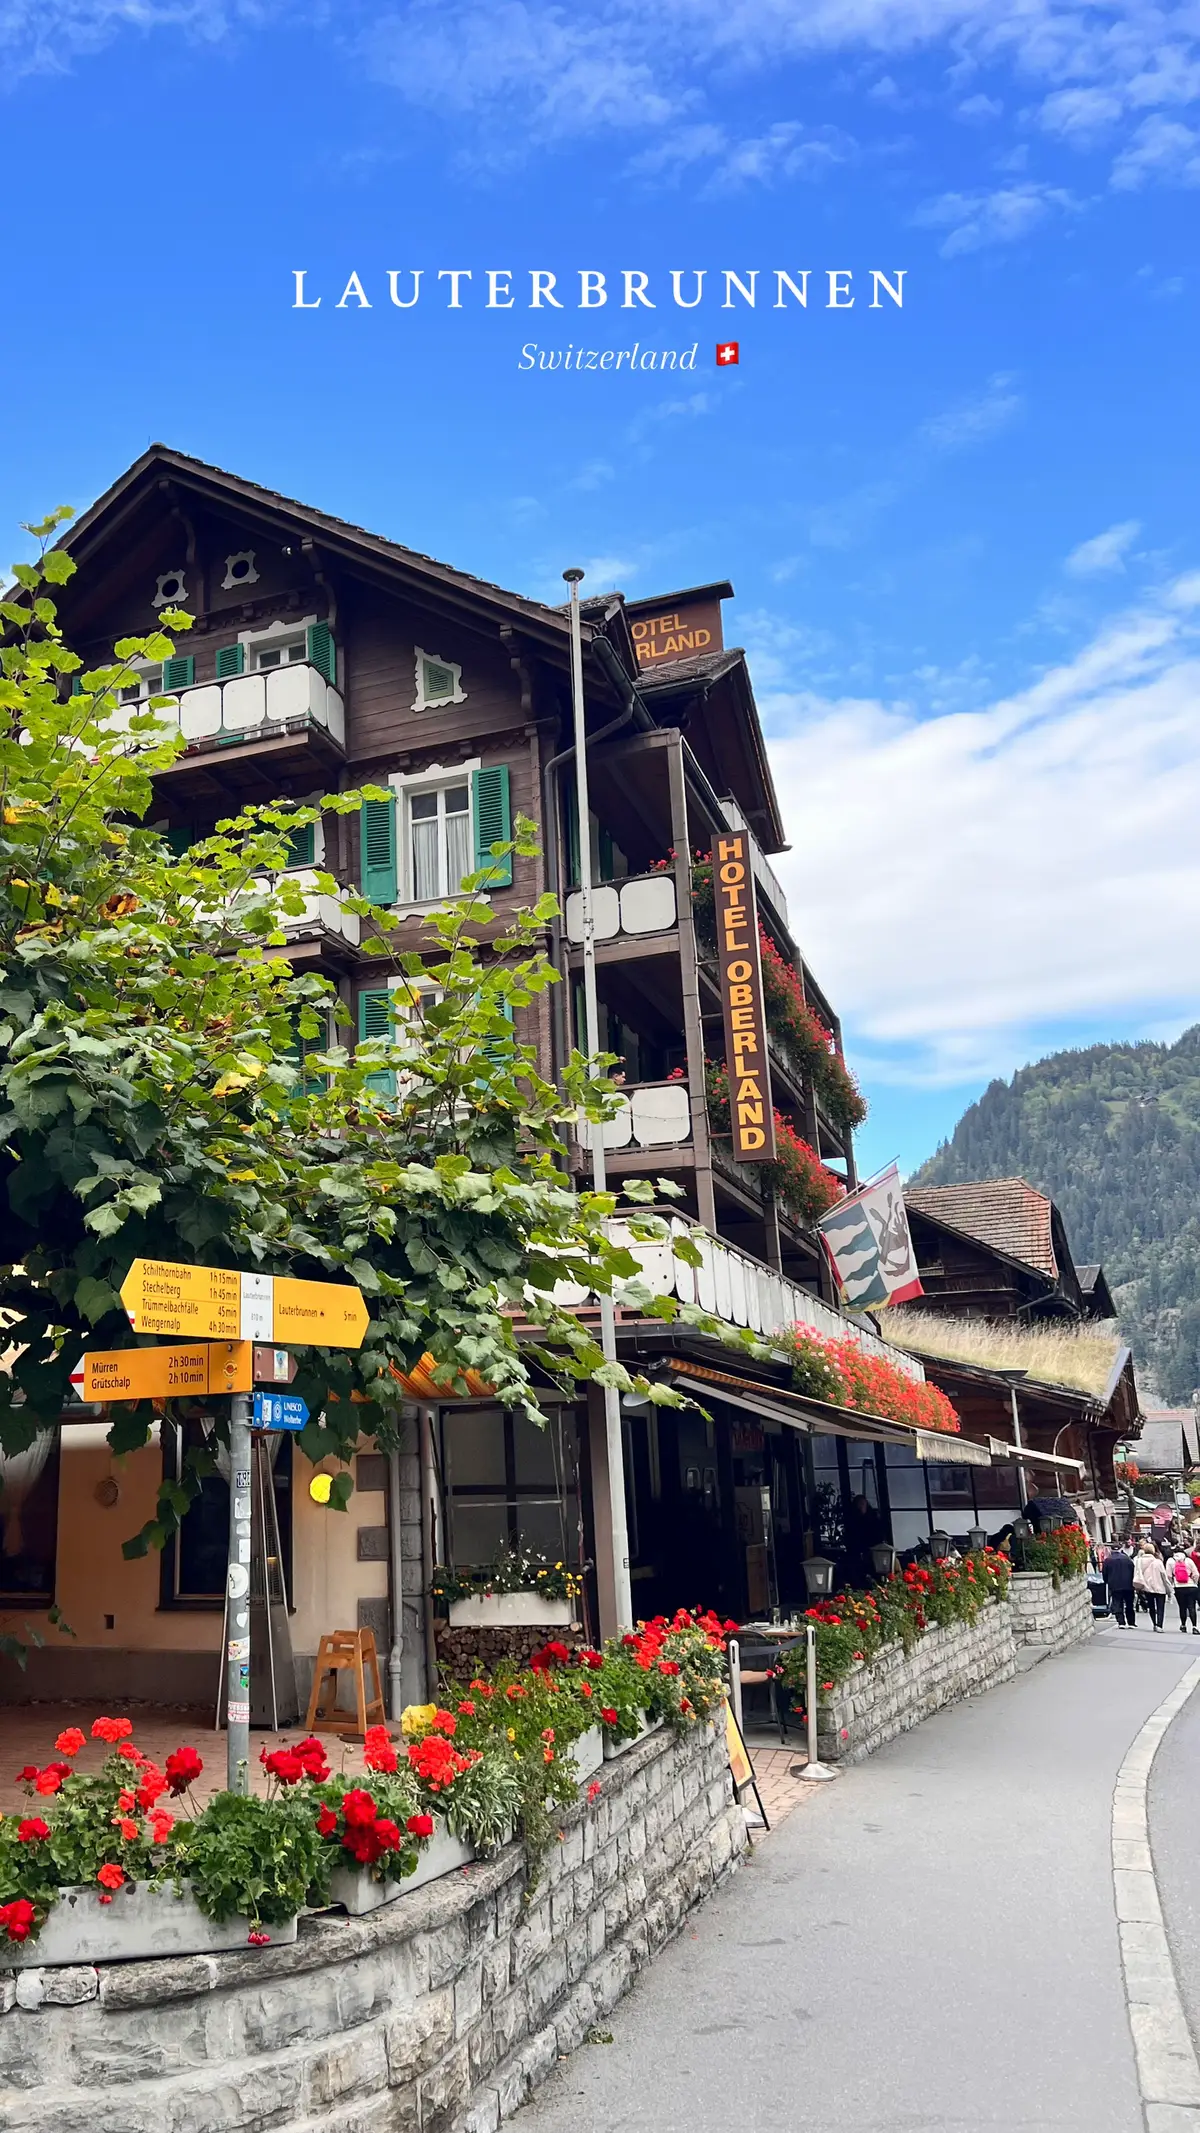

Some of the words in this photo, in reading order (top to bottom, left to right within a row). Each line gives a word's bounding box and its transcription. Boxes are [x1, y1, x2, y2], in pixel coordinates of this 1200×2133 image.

[718, 837, 749, 952] HOTEL
[726, 960, 766, 1151] OBERLAND
[143, 1263, 192, 1280] Schilthornbahn
[142, 1280, 181, 1299] Stechelberg
[142, 1298, 199, 1315] Trümmelbachfälle
[278, 1304, 318, 1318] Lauterbrunnen
[141, 1316, 181, 1333] Wengernalp
[91, 1362, 118, 1374] Mürren
[91, 1376, 131, 1390] Grütschalp
[283, 1402, 302, 1412] UNESCO
